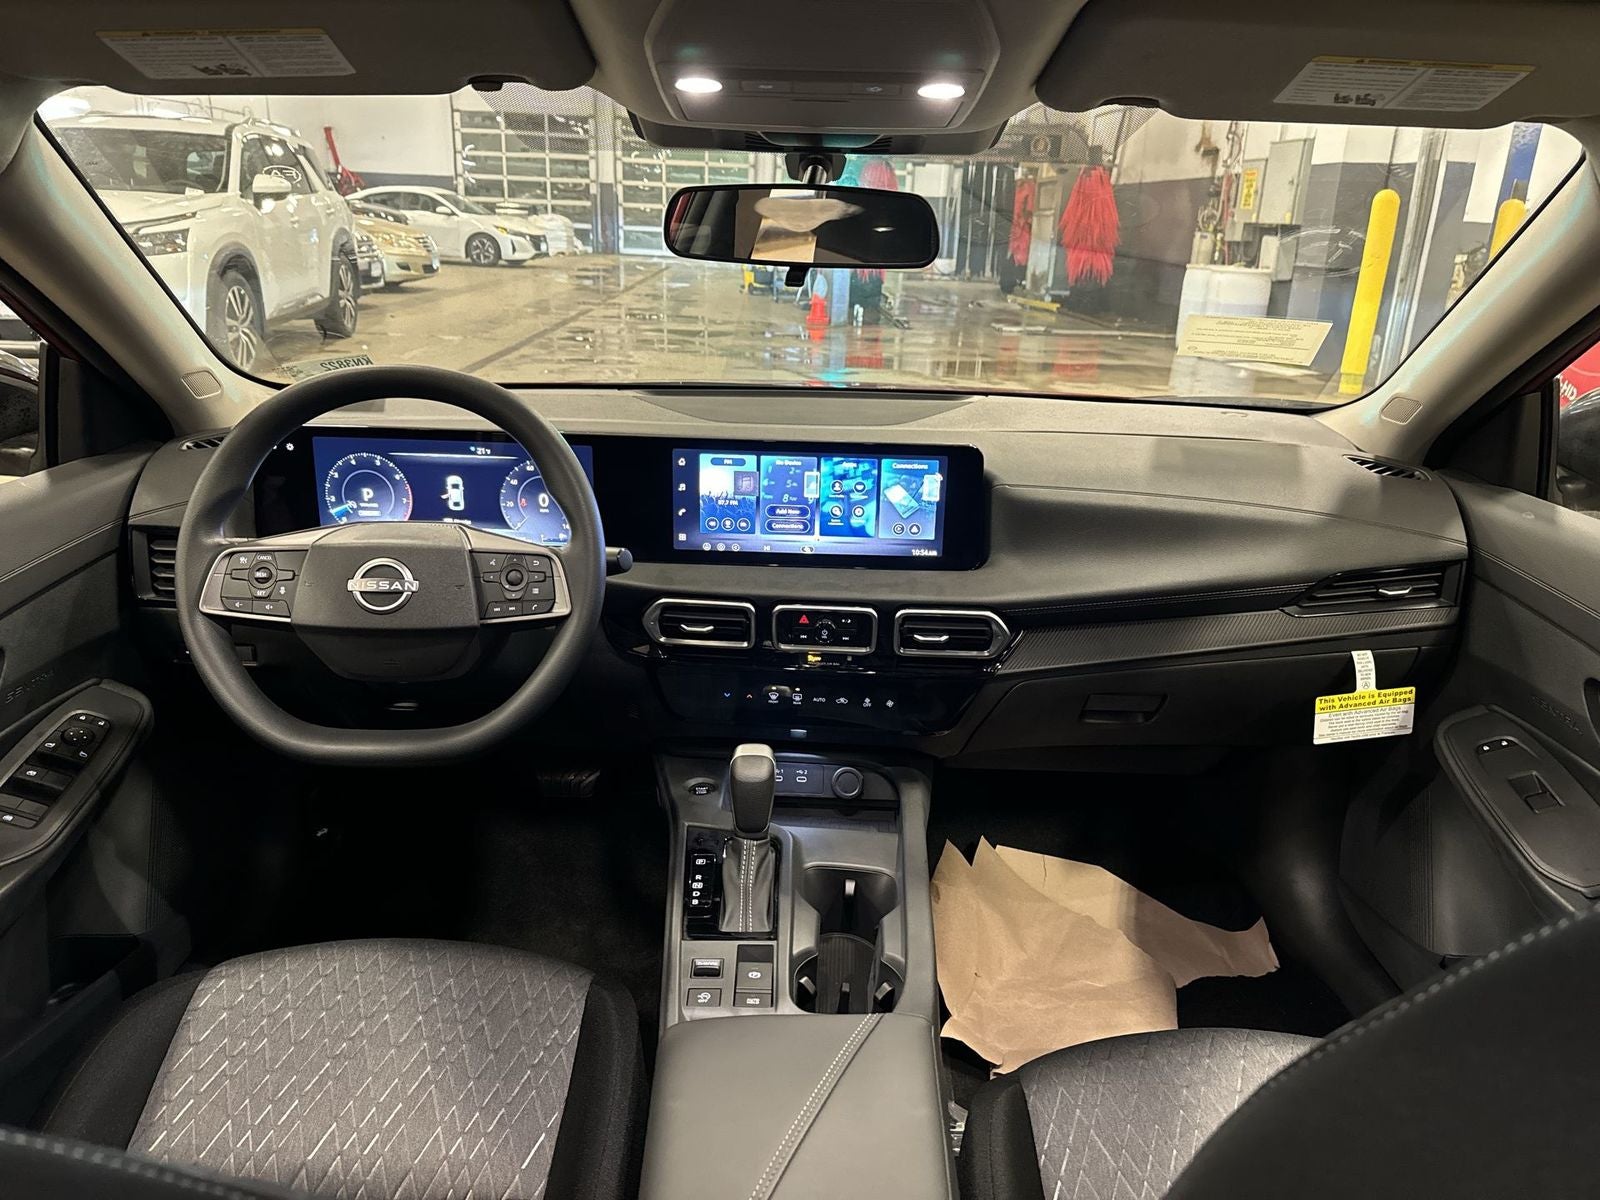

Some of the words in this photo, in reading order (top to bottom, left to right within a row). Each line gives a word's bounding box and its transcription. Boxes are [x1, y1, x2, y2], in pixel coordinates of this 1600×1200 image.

[361, 488, 374, 501] P
[538, 493, 549, 507] 0
[349, 580, 417, 591] NISSAN
[1337, 694, 1366, 703] Vehicle
[1377, 689, 1413, 699] Equipped
[1338, 700, 1377, 710] Advanced
[1392, 696, 1412, 704] Bags
